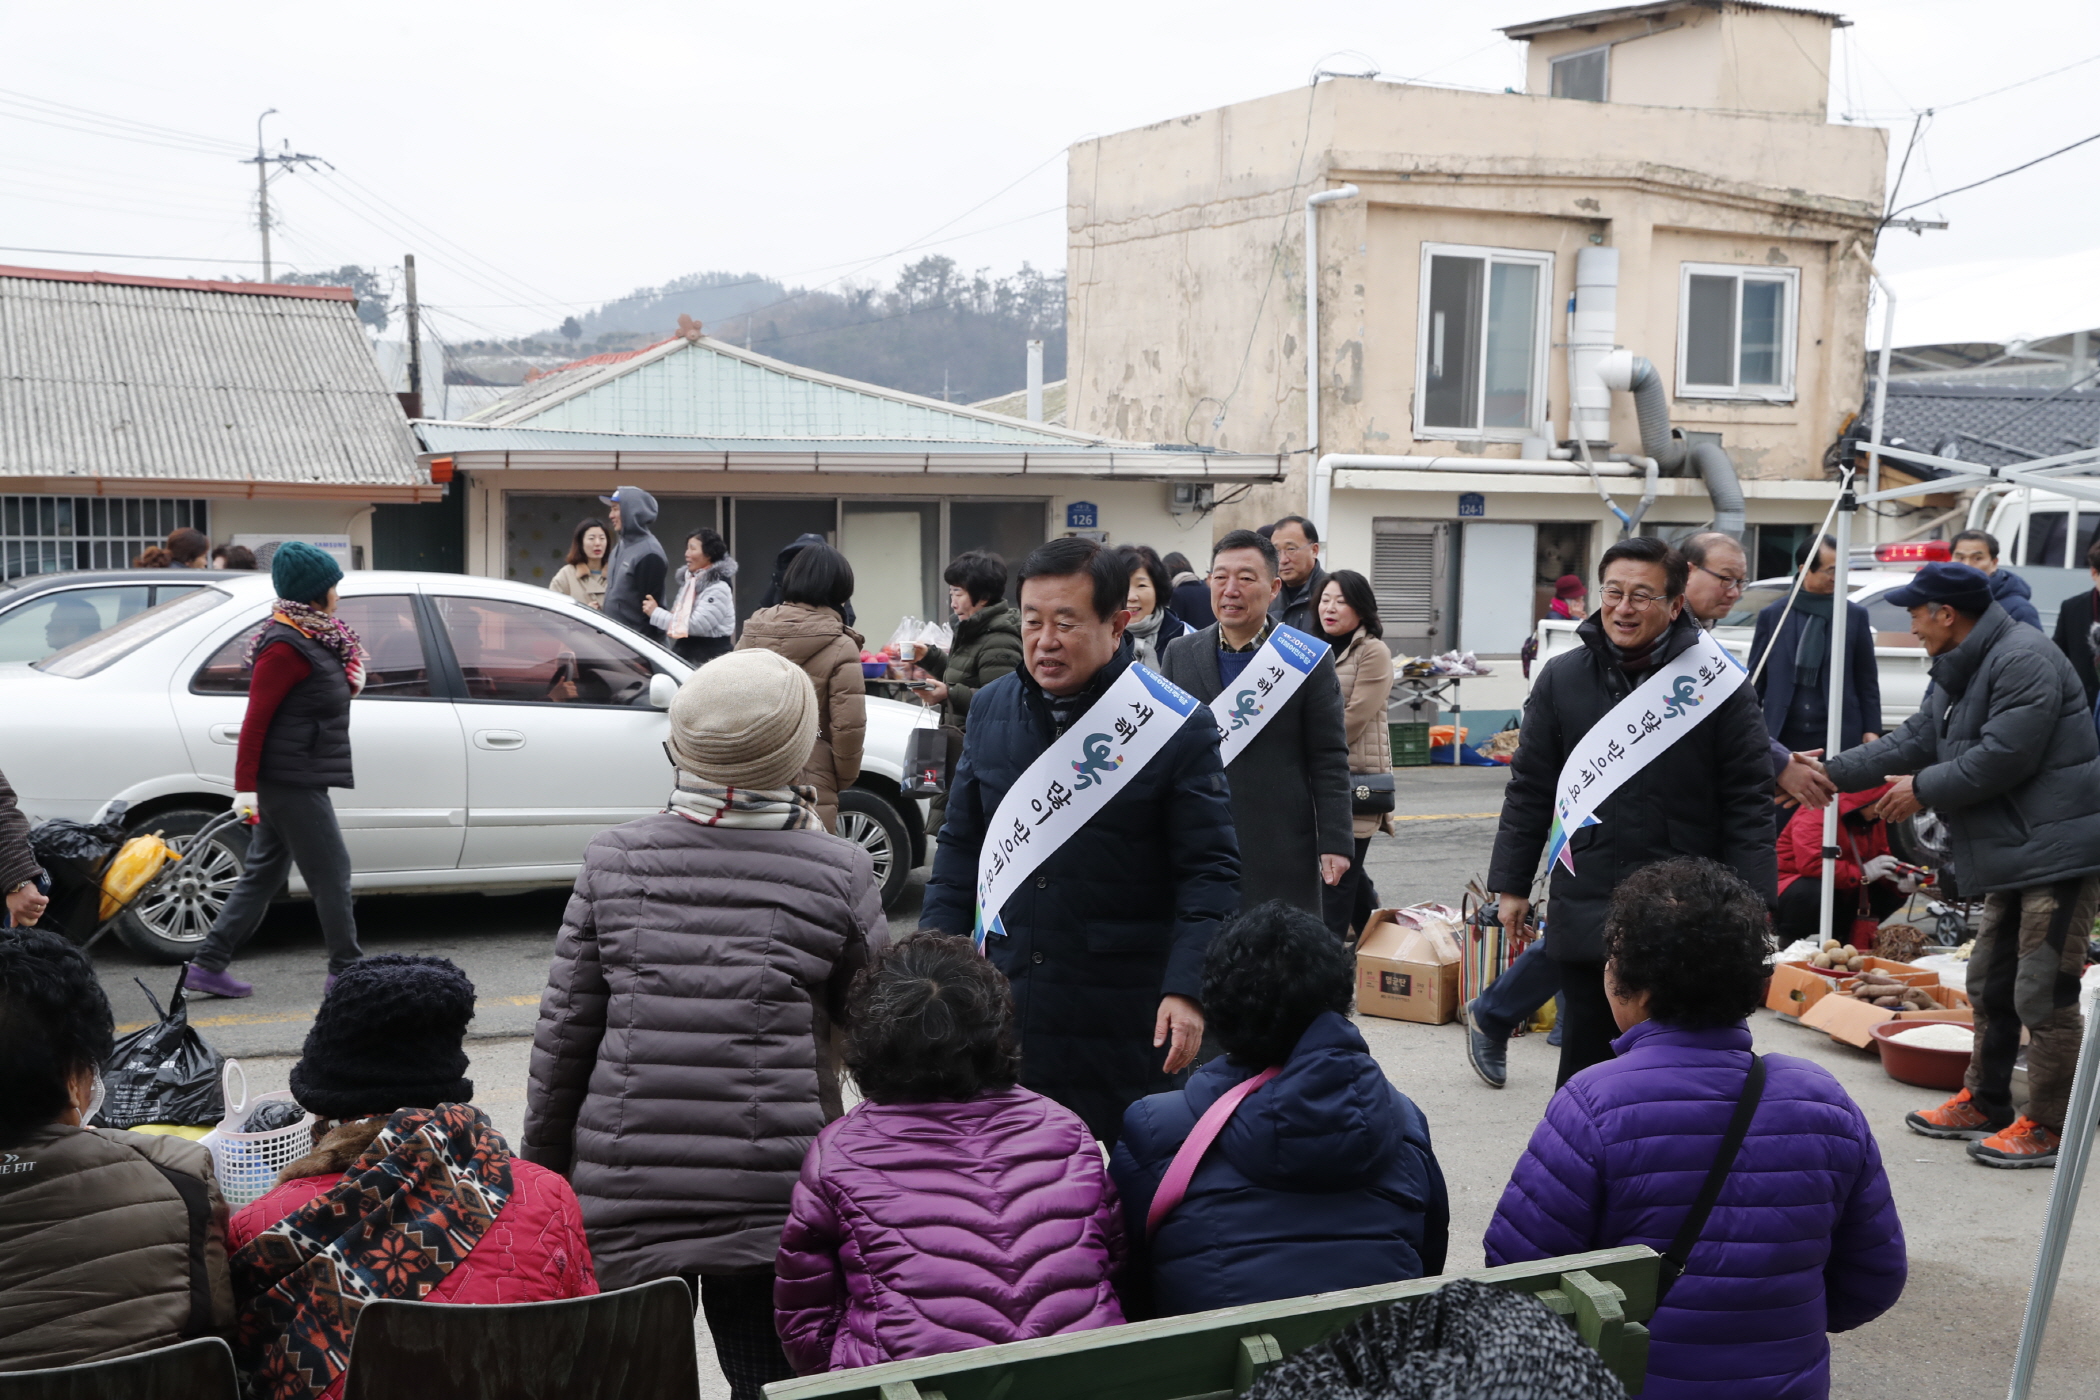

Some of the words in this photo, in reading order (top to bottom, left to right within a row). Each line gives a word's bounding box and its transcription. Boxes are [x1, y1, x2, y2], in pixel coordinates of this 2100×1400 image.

[1072, 514, 1092, 525] 126
[1461, 504, 1482, 514] 124-1
[1277, 637, 1311, 665] 더불어민주당
[1257, 665, 1285, 698] 새해
[1698, 655, 1728, 688] 새해
[1114, 701, 1154, 746] 새해
[1627, 709, 1662, 745] 많이
[1568, 740, 1626, 804] 받으세요
[1031, 780, 1073, 827] 많이
[984, 817, 1031, 894] 받으세요
[14, 1161, 37, 1173] FIT
